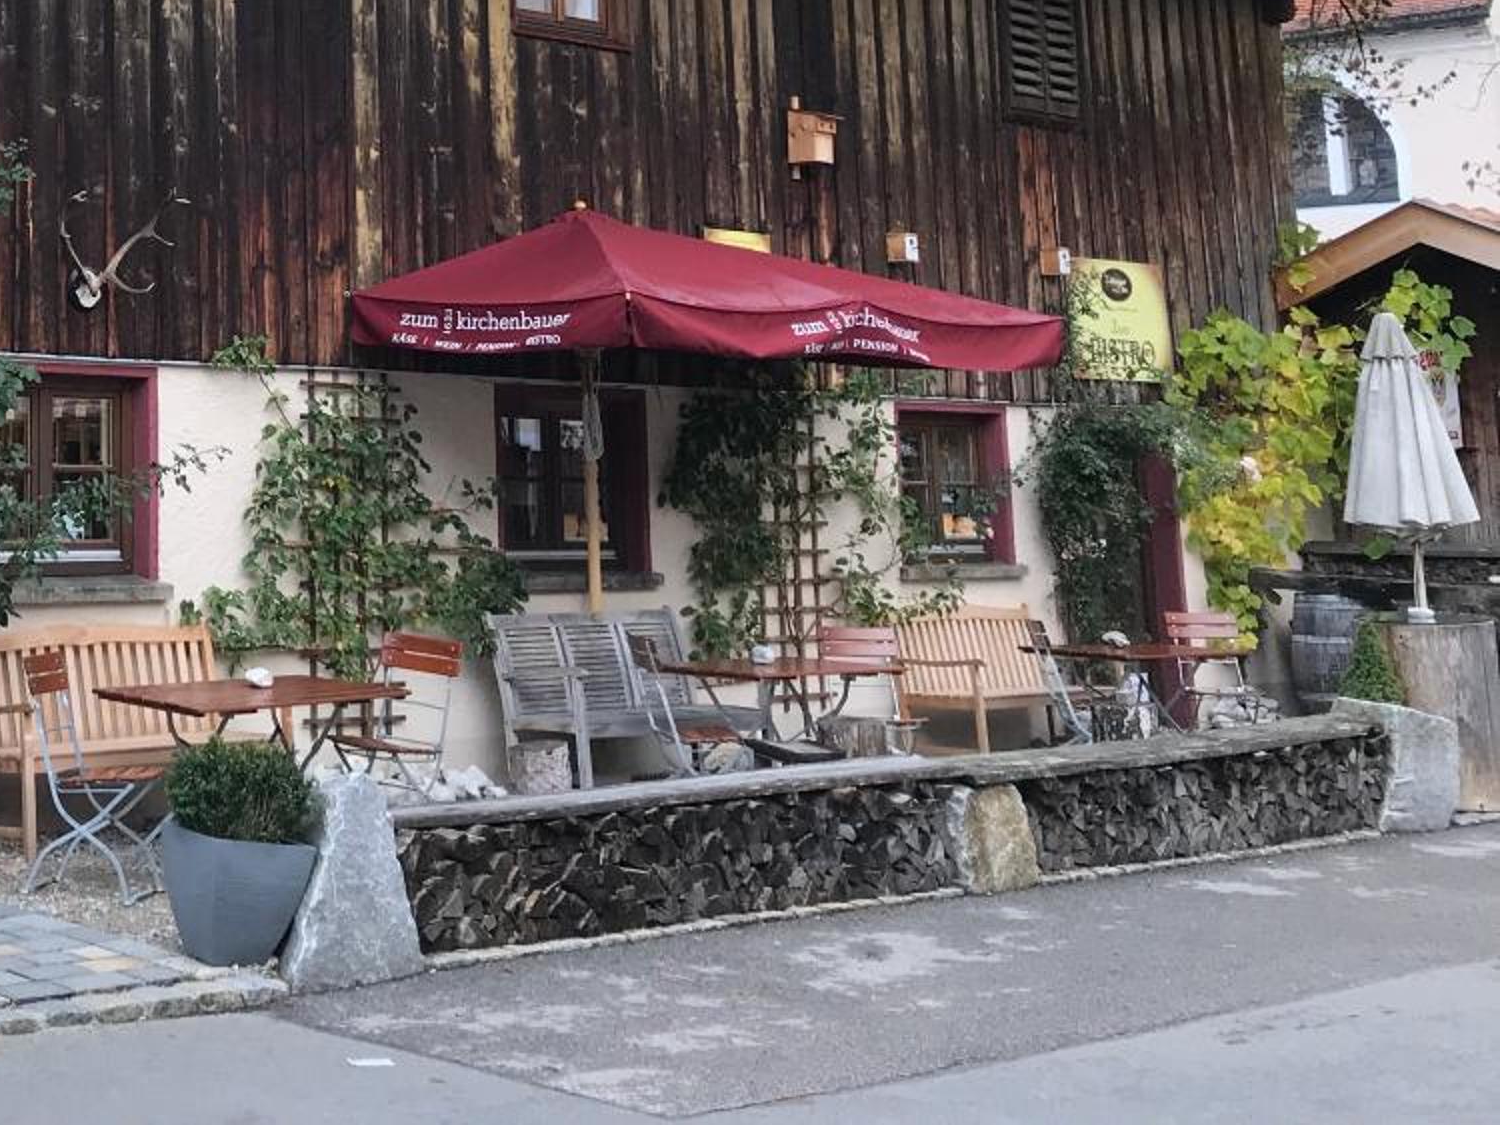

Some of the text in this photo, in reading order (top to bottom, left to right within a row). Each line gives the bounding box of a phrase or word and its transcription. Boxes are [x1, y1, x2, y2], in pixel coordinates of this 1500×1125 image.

[400, 312, 438, 329] zum
[456, 310, 571, 331] kirchenbauer
[791, 320, 830, 336] zum
[853, 338, 899, 353] PENSION
